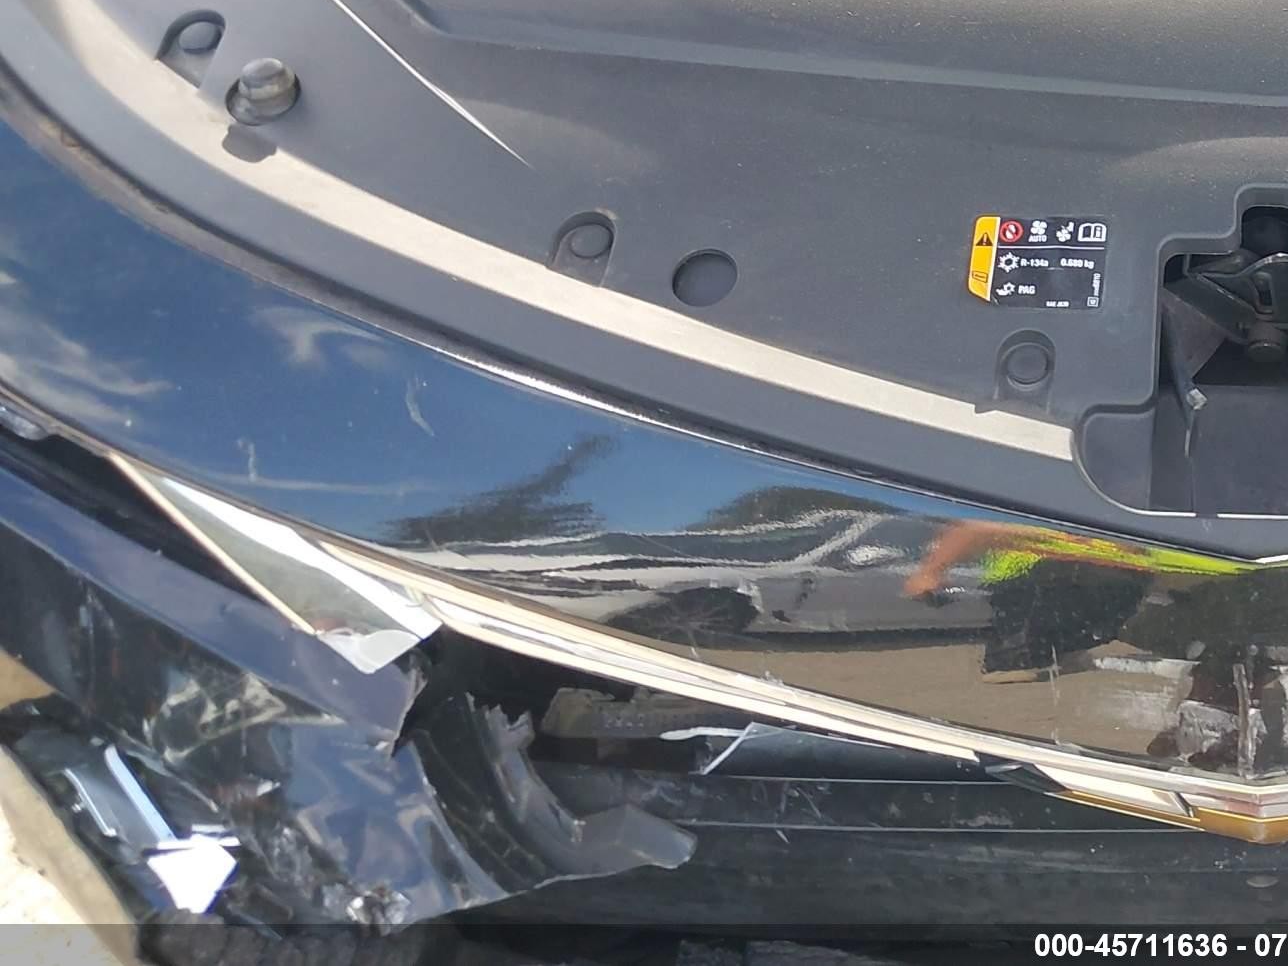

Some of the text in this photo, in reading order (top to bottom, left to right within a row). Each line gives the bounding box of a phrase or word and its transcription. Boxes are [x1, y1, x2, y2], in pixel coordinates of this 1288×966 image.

[1028, 234, 1048, 243] AUTO
[1020, 258, 1049, 267] R-134a
[1084, 259, 1094, 270] kg
[1018, 284, 1036, 295] PAG
